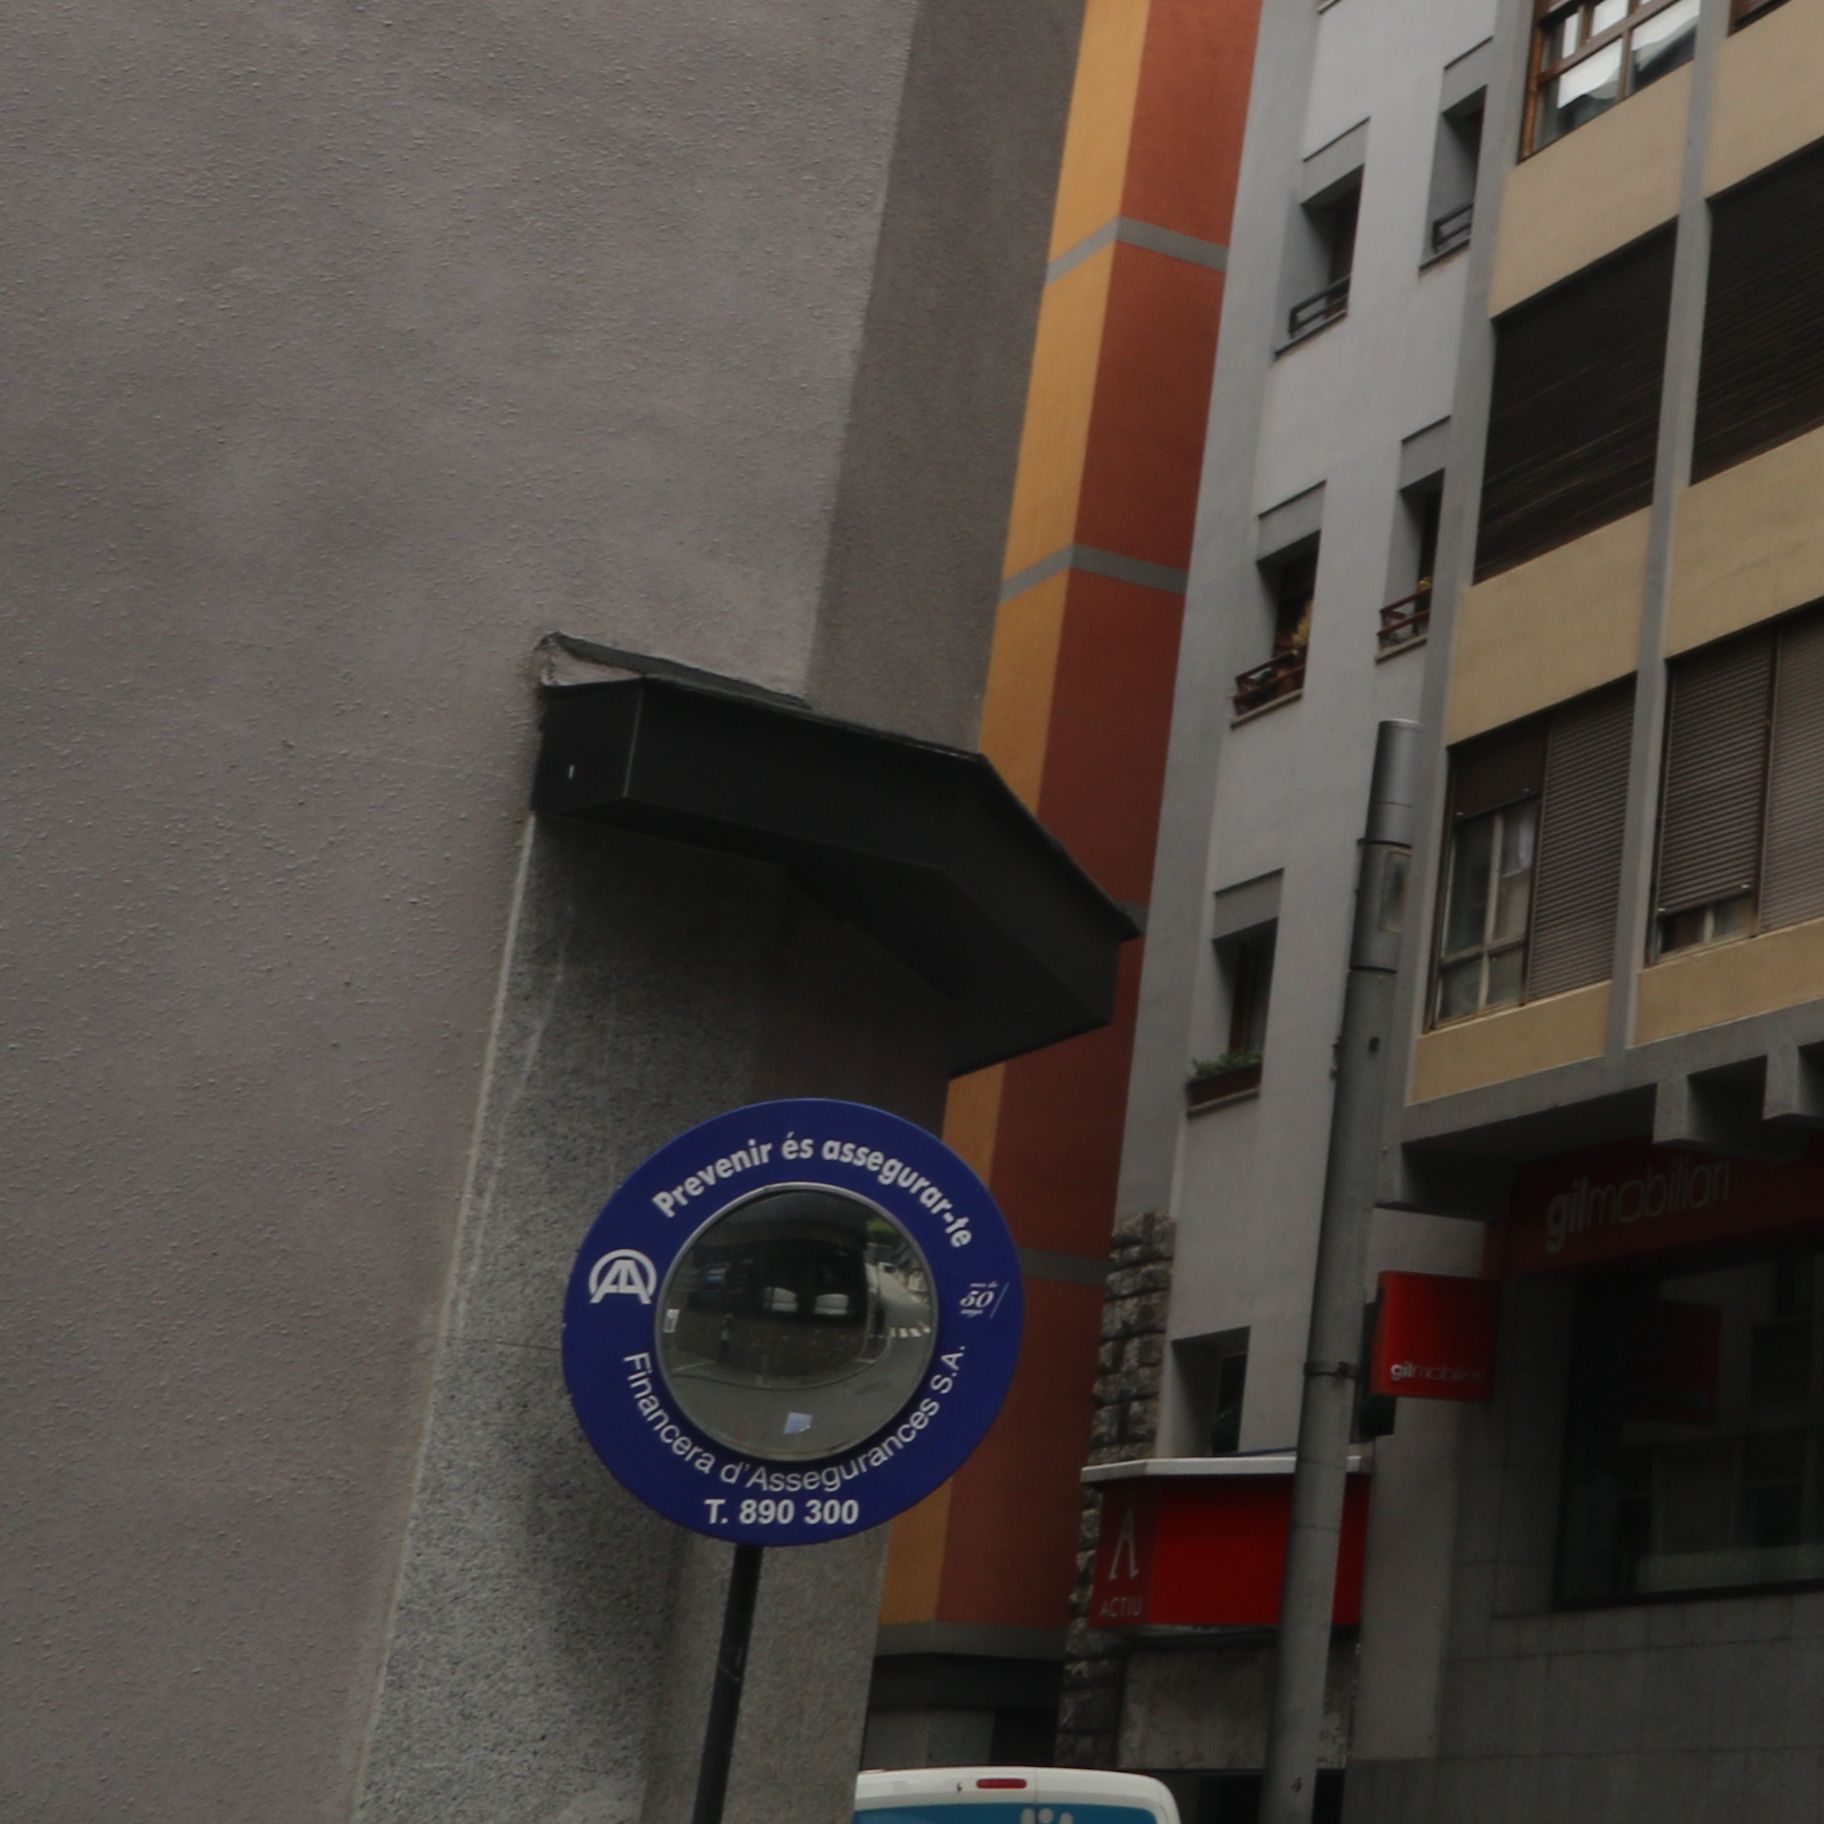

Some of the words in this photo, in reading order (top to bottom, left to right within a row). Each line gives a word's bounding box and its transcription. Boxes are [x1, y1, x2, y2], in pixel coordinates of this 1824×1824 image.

[652, 1138, 773, 1218] Prevenir
[782, 1131, 813, 1160] és
[822, 1139, 972, 1249] assegurar-te
[960, 1289, 995, 1308] 50
[623, 1351, 716, 1474] Financera
[720, 1398, 940, 1493] d'Assegurances
[930, 1344, 966, 1394] S.A.
[705, 1499, 728, 1525] T.
[739, 1498, 795, 1525] 890
[804, 1498, 860, 1525] 300
[1101, 1595, 1143, 1618] ACTIU
